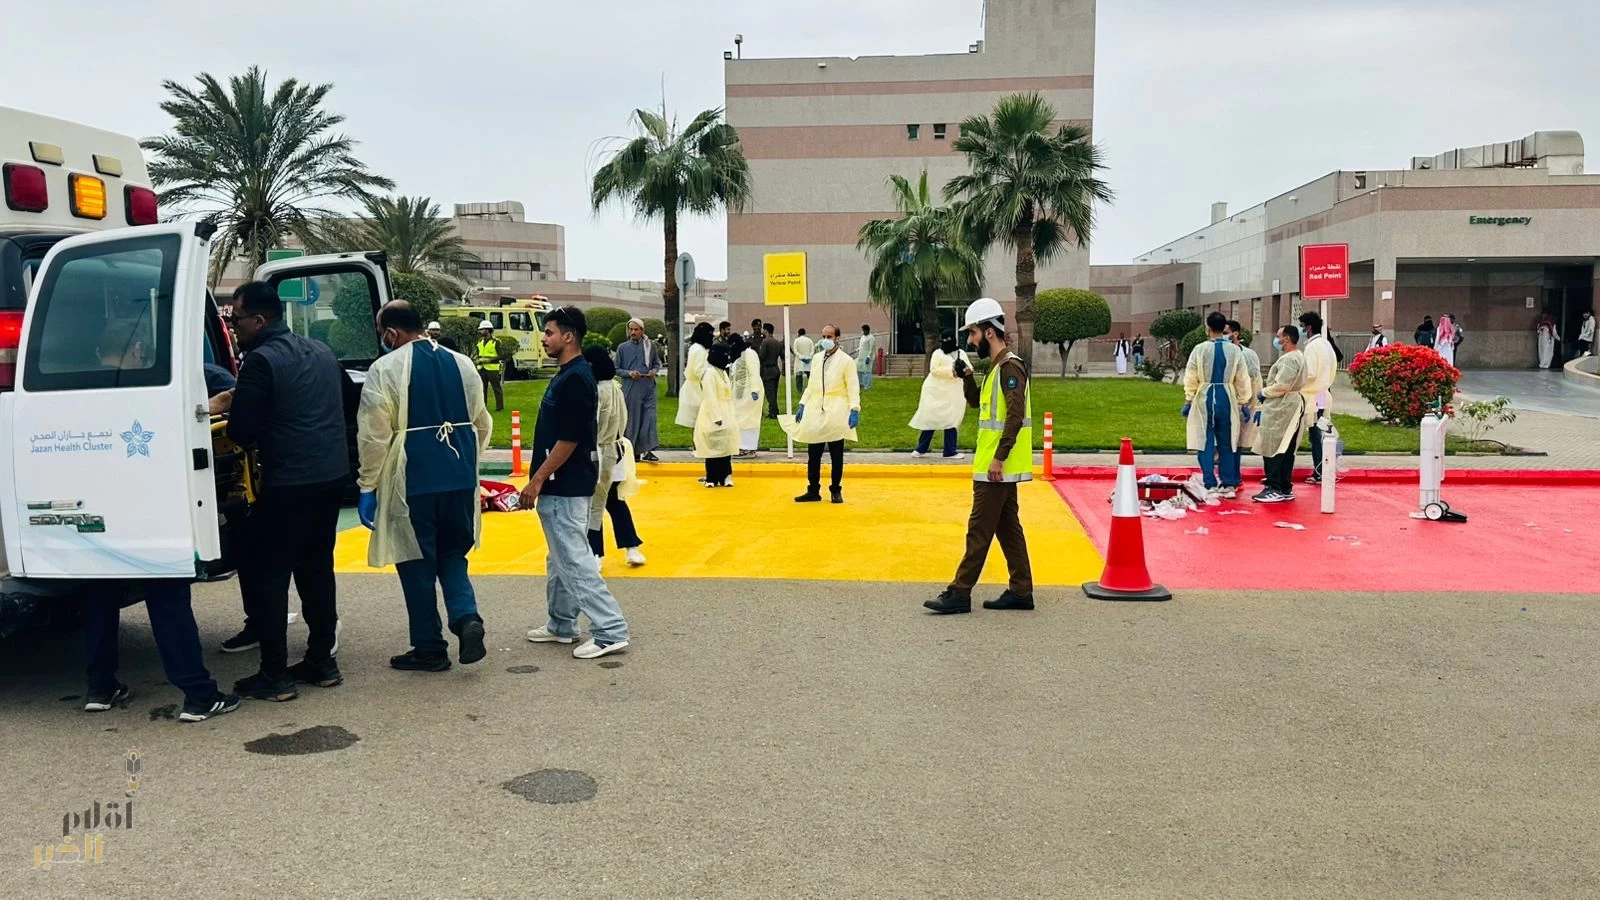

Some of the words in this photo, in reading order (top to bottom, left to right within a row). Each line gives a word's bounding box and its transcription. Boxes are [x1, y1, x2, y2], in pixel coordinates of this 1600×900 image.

[1469, 215, 1532, 226] Emergency
[30, 430, 56, 443] الصحي
[57, 429, 85, 441] جازان
[87, 429, 113, 441] تجمع
[30, 444, 53, 453] Jazan
[54, 442, 81, 452] Health
[83, 441, 113, 451] Cluster
[29, 513, 105, 525] SAVANA
